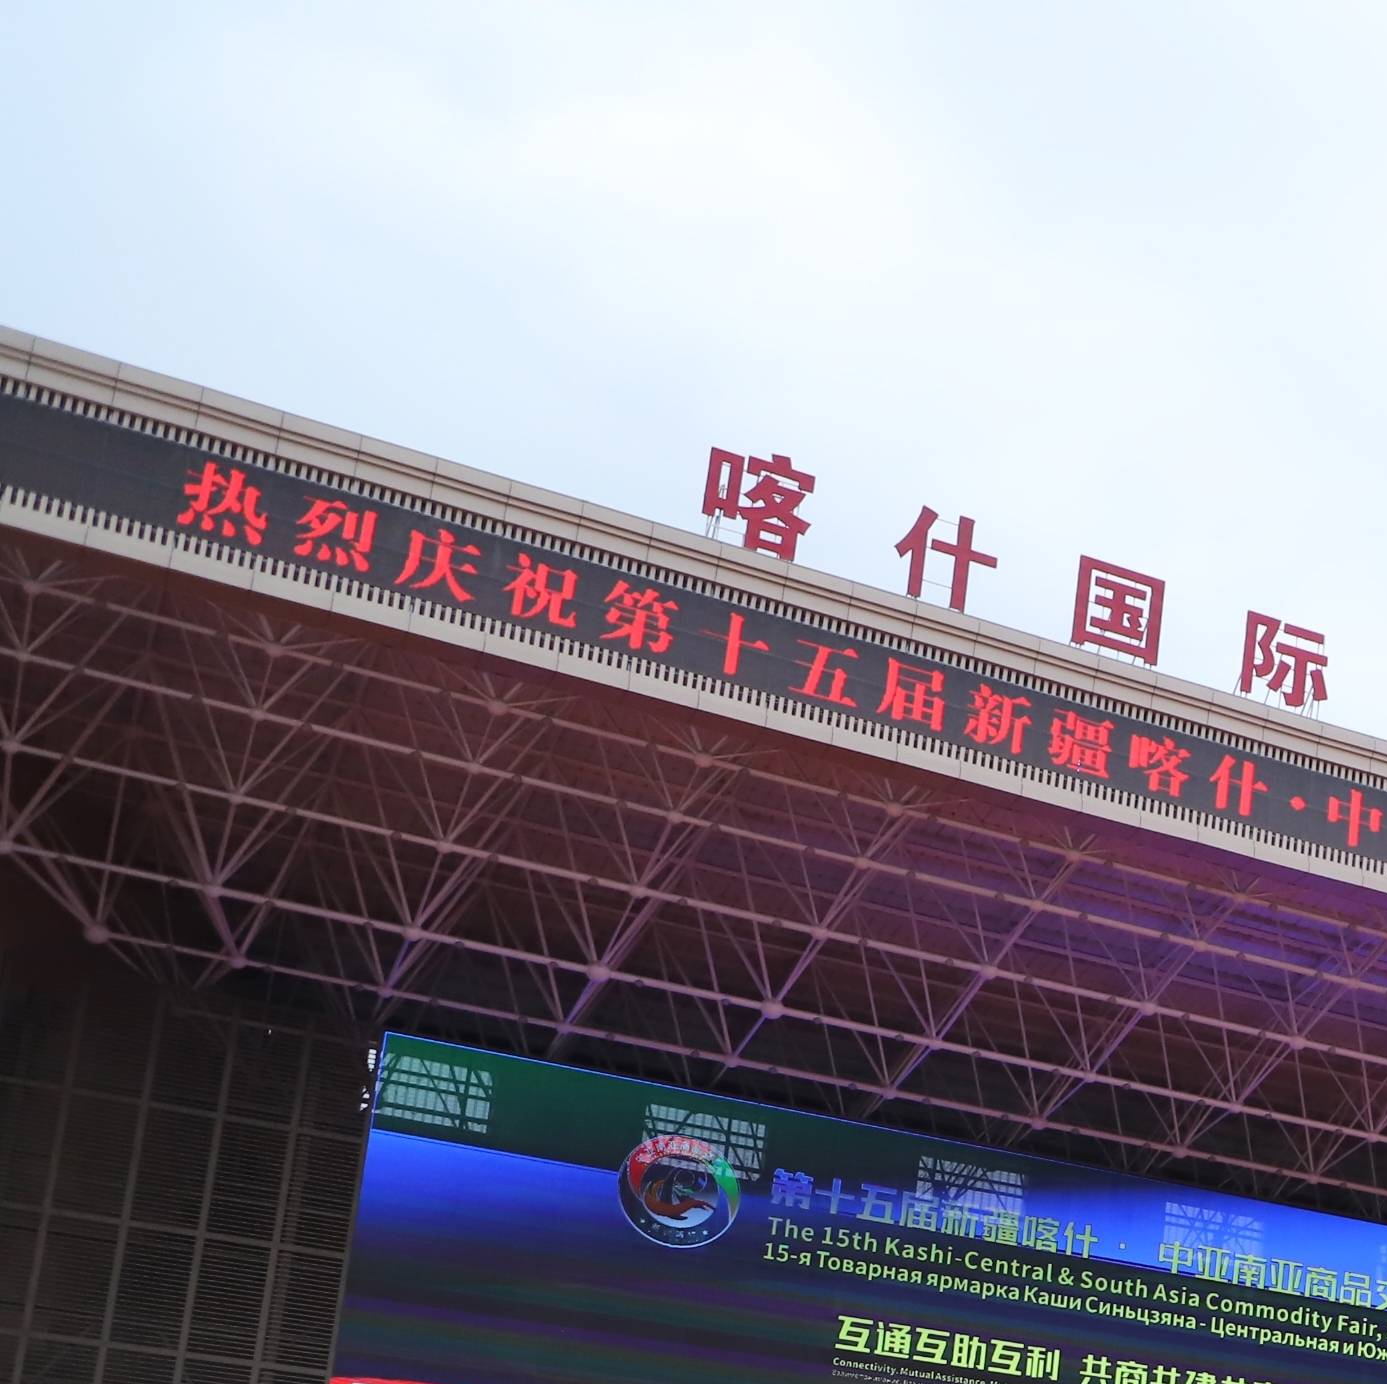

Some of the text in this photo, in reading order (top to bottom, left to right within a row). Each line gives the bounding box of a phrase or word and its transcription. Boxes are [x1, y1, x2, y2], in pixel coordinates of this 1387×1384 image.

[763, 1242, 811, 1267] 15-я
[816, 1250, 923, 1285] Товарная
[926, 1273, 1020, 1302] ярмарка
[1023, 1285, 1082, 1312] Каши
[1085, 1295, 1197, 1330] Синьцзяна
[1210, 1316, 1340, 1354] Центральная
[1342, 1340, 1355, 1356] и
[767, 1216, 815, 1242] The
[822, 1226, 878, 1253] 15th
[884, 1237, 1053, 1283] Kashi-Central
[1058, 1267, 1075, 1287] &
[1080, 1270, 1148, 1300] South
[1152, 1286, 1200, 1307] Asia
[1206, 1293, 1333, 1333] Commodity
[1337, 1315, 1382, 1341] Fair,
[834, 1315, 1061, 1382] 互通互助互利
[900, 1366, 934, 1380] Mutual
